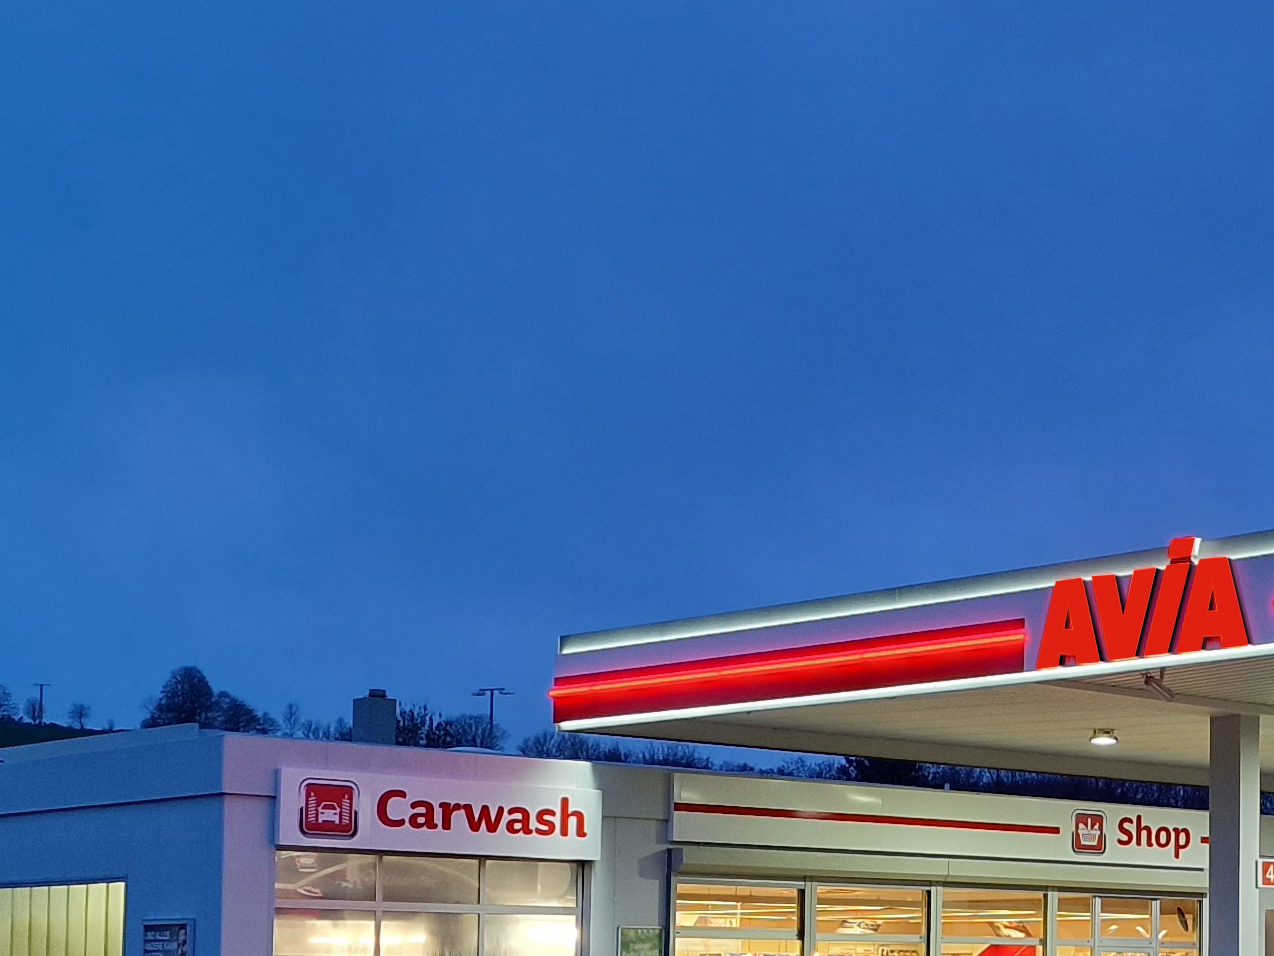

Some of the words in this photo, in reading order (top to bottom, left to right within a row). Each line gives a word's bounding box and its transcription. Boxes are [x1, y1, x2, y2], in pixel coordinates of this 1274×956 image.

[376, 789, 588, 838] Carwash
[1116, 814, 1191, 860] Shop
[1265, 864, 1274, 883] 4
